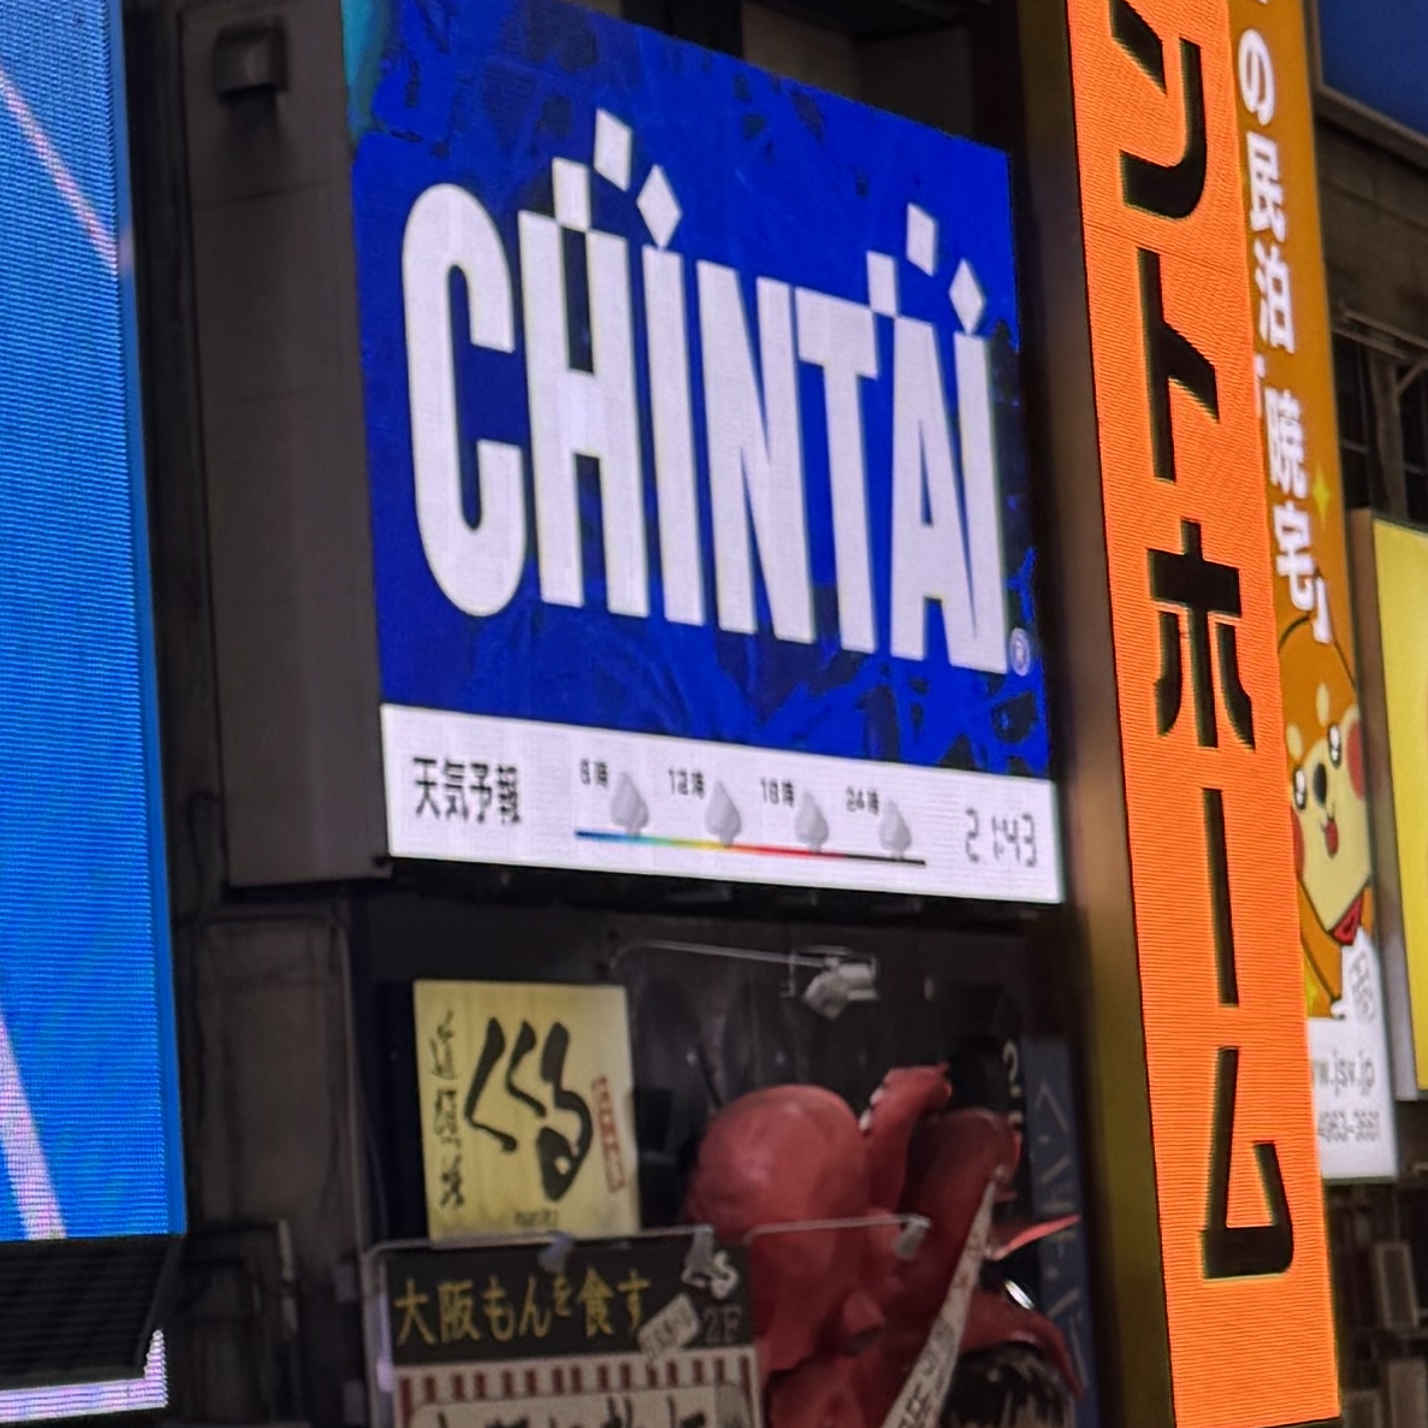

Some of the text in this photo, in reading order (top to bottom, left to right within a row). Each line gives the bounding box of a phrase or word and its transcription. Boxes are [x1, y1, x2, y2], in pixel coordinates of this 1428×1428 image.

[402, 110, 1007, 675] CHINTAI
[411, 755, 522, 825] 天気予報
